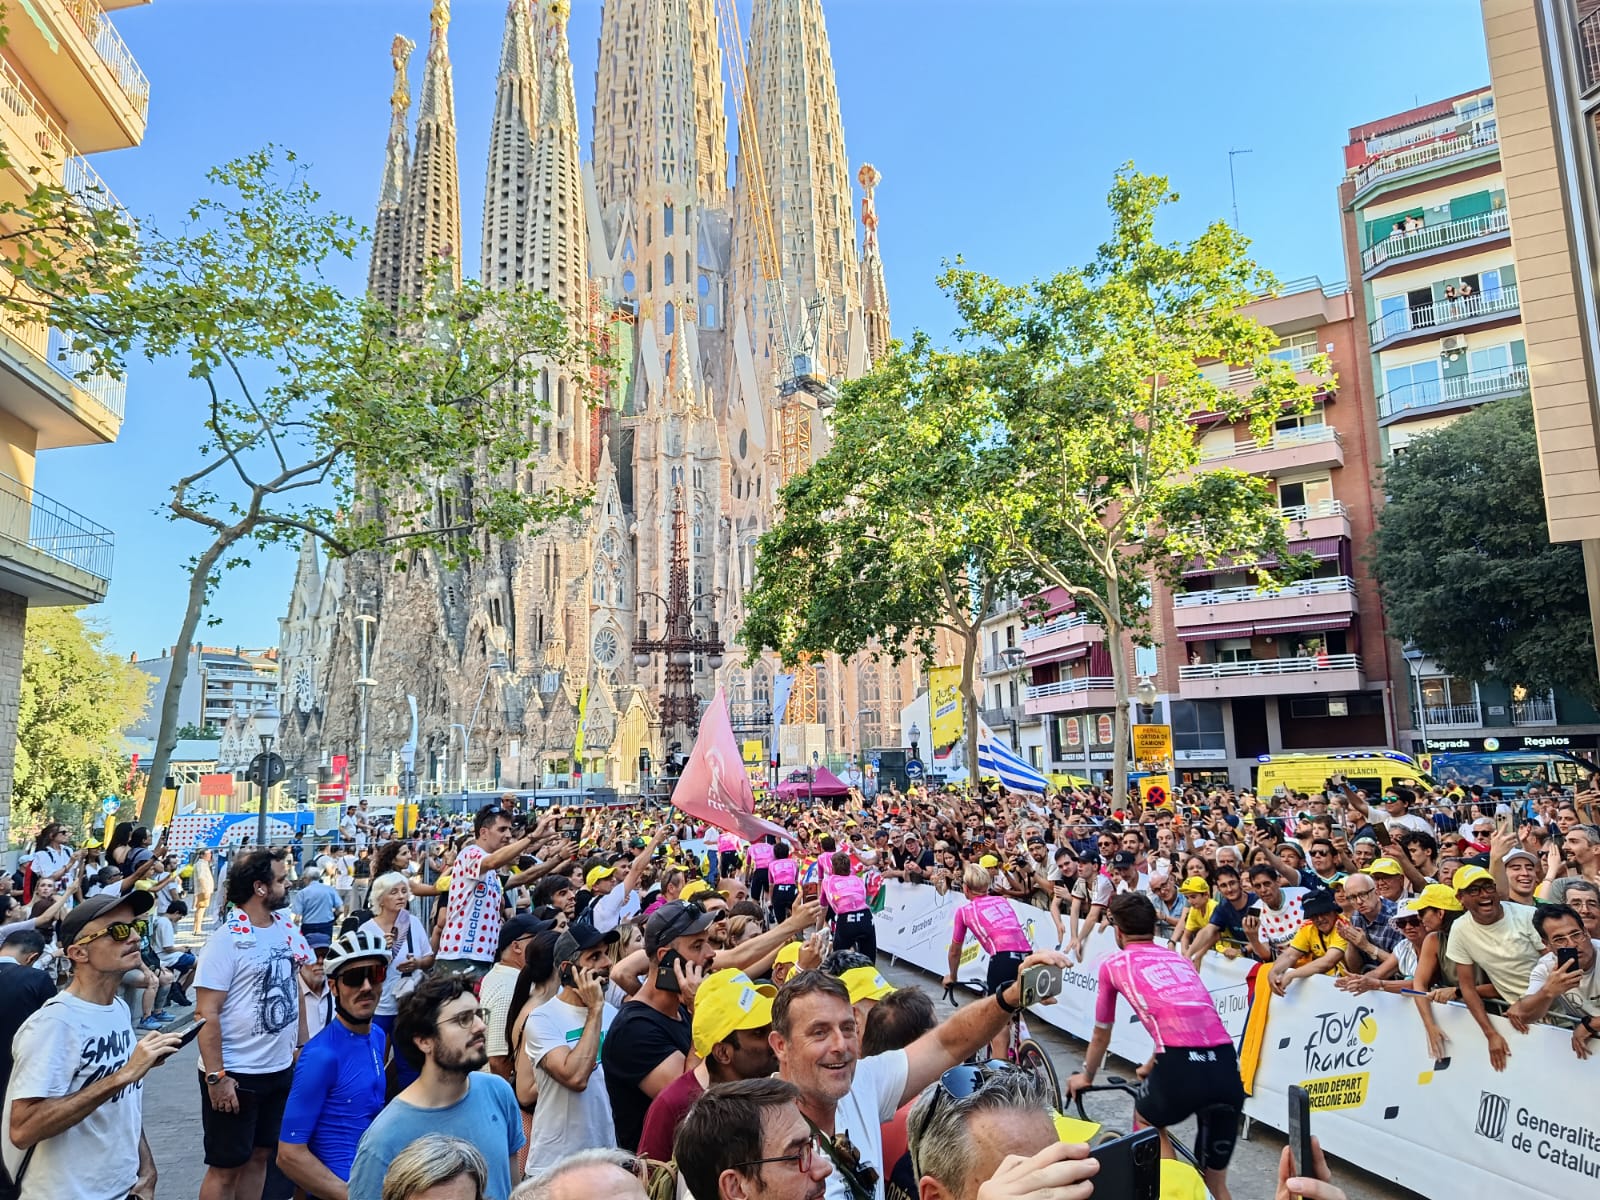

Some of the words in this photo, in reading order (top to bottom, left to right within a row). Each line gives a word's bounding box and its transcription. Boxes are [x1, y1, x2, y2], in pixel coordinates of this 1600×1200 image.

[1426, 739, 1470, 750] Sagrada
[1524, 736, 1570, 748] Regalos
[463, 899, 483, 953] E.Leclerc
[1347, 1034, 1358, 1047] de
[1330, 1077, 1363, 1093] DÉPART
[1309, 1093, 1342, 1108] RCELONE
[1342, 1091, 1361, 1105] 2026
[1511, 1132, 1532, 1153] de
